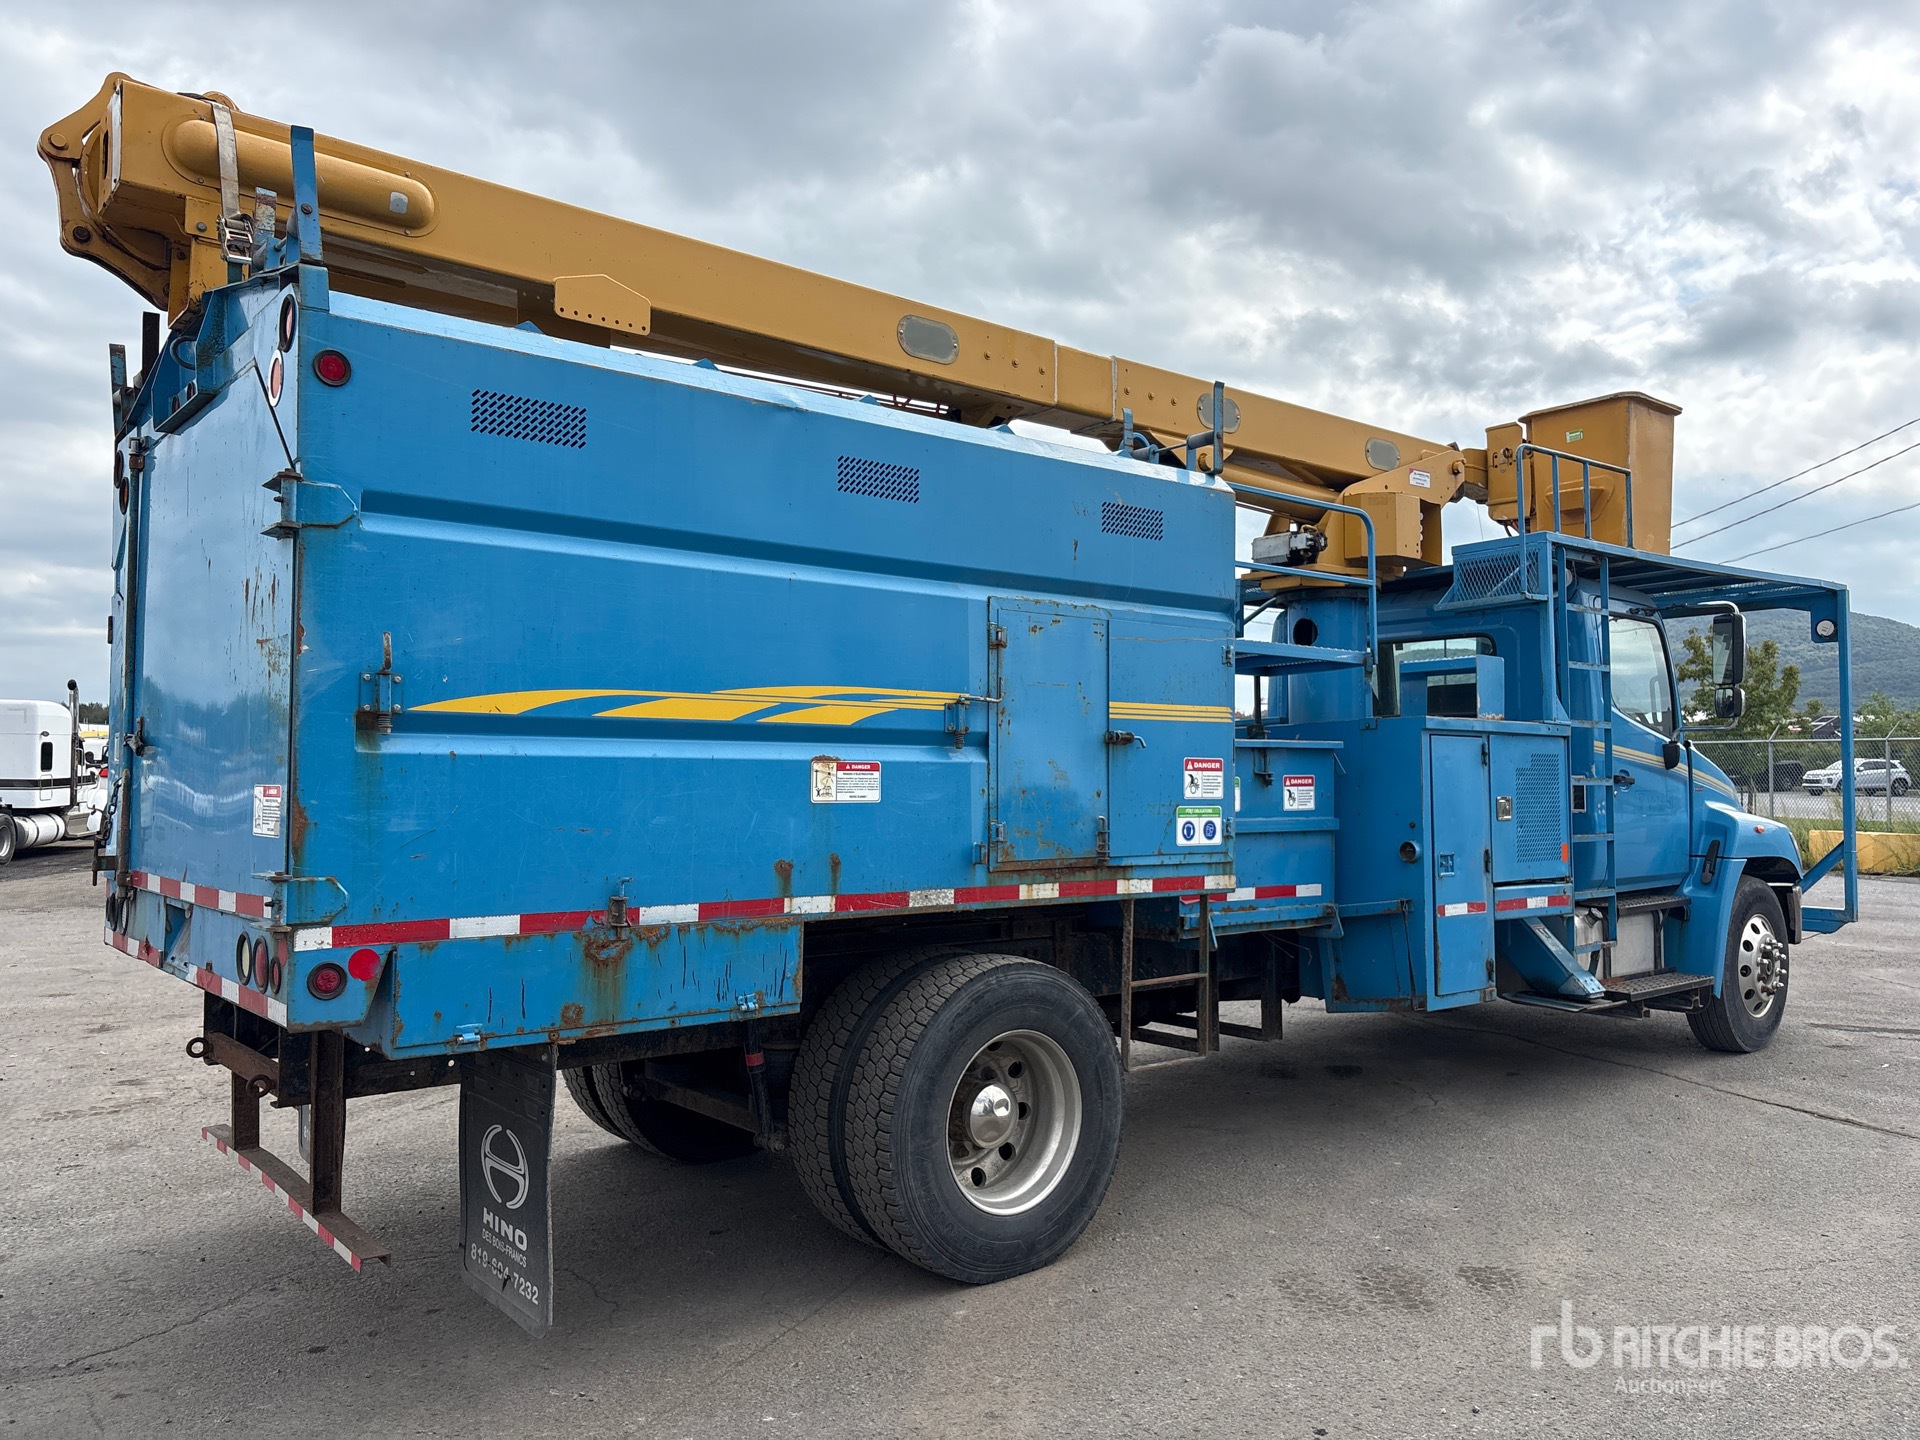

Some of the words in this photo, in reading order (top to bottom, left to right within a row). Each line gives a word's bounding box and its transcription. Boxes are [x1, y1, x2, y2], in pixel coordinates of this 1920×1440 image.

[1193, 761, 1220, 769] DANGER
[482, 1206, 527, 1252] HINO
[482, 1228, 492, 1244] DES
